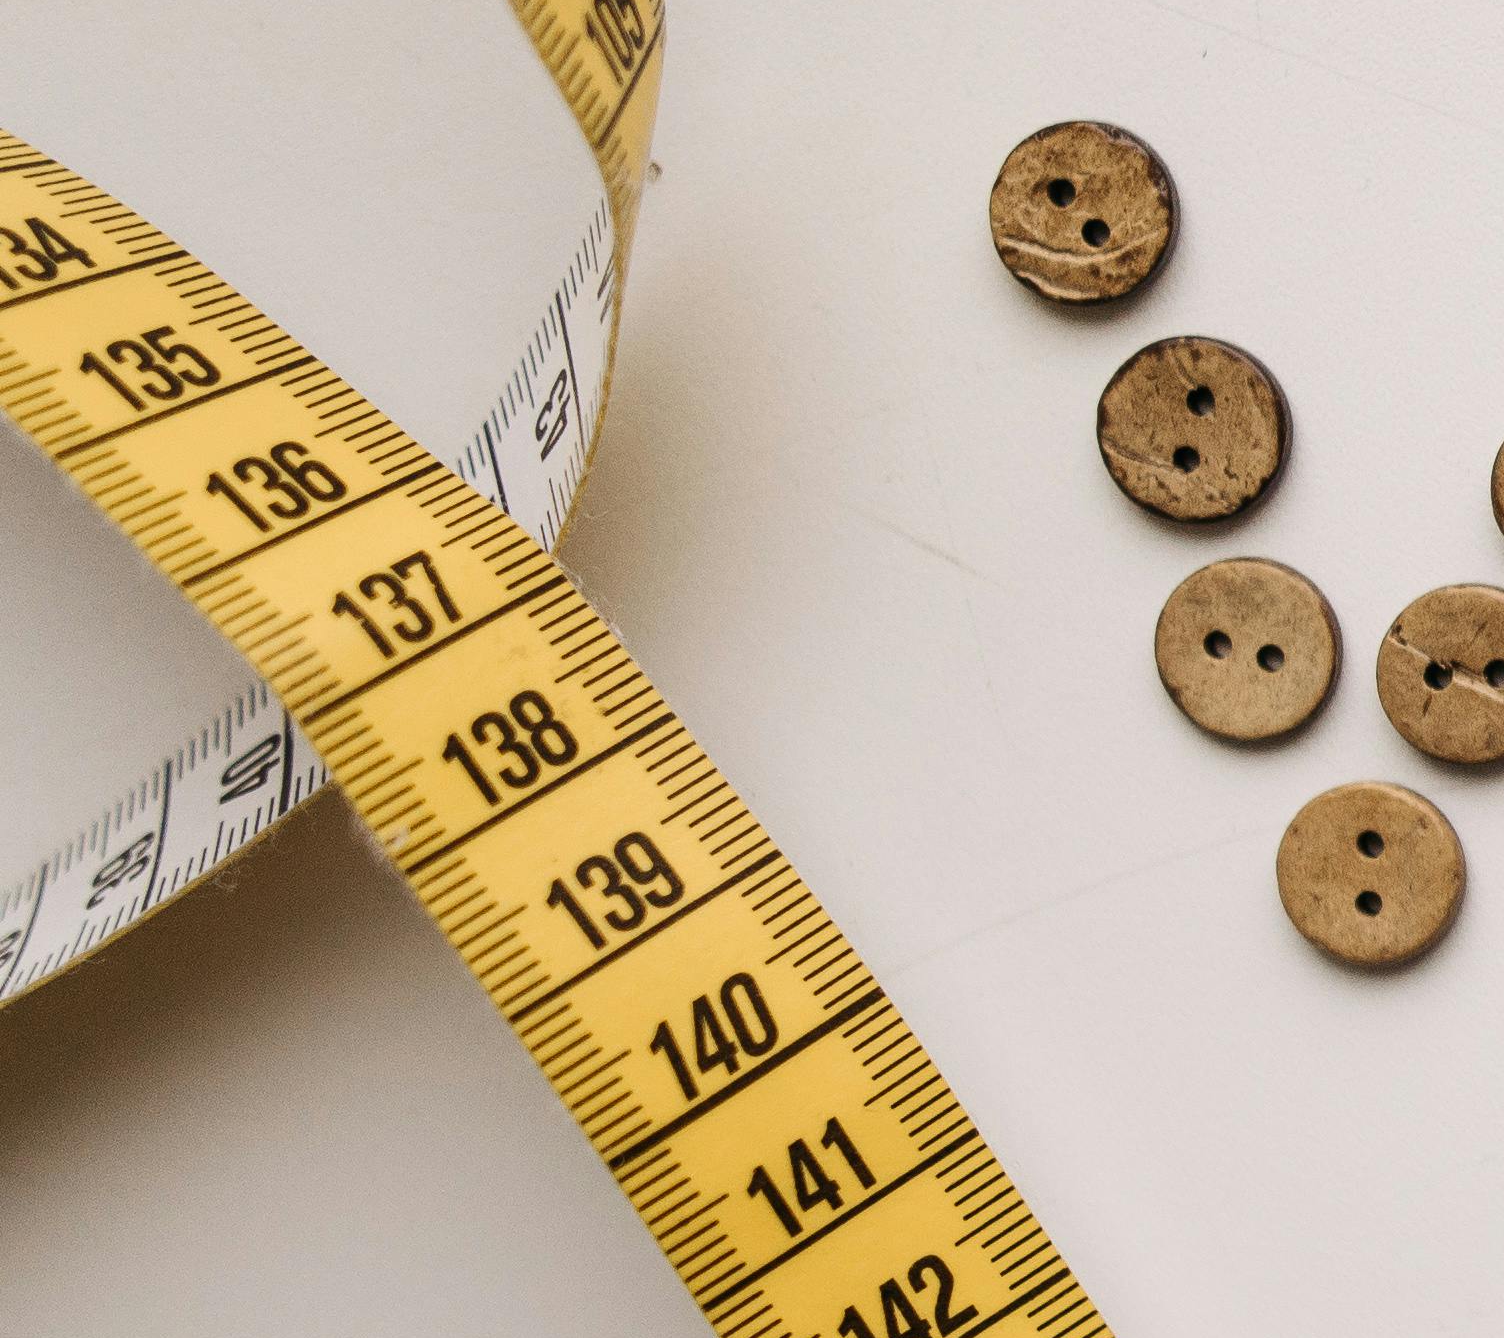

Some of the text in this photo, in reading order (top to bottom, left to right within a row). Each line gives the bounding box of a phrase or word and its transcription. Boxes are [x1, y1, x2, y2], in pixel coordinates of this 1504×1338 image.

[79, 325, 222, 412] 135
[206, 440, 349, 533] 136
[331, 550, 464, 660] 137
[219, 733, 282, 805] 40
[442, 689, 579, 806] 138
[546, 831, 686, 950] 139
[649, 972, 779, 1102] 140
[746, 1117, 878, 1238] 141
